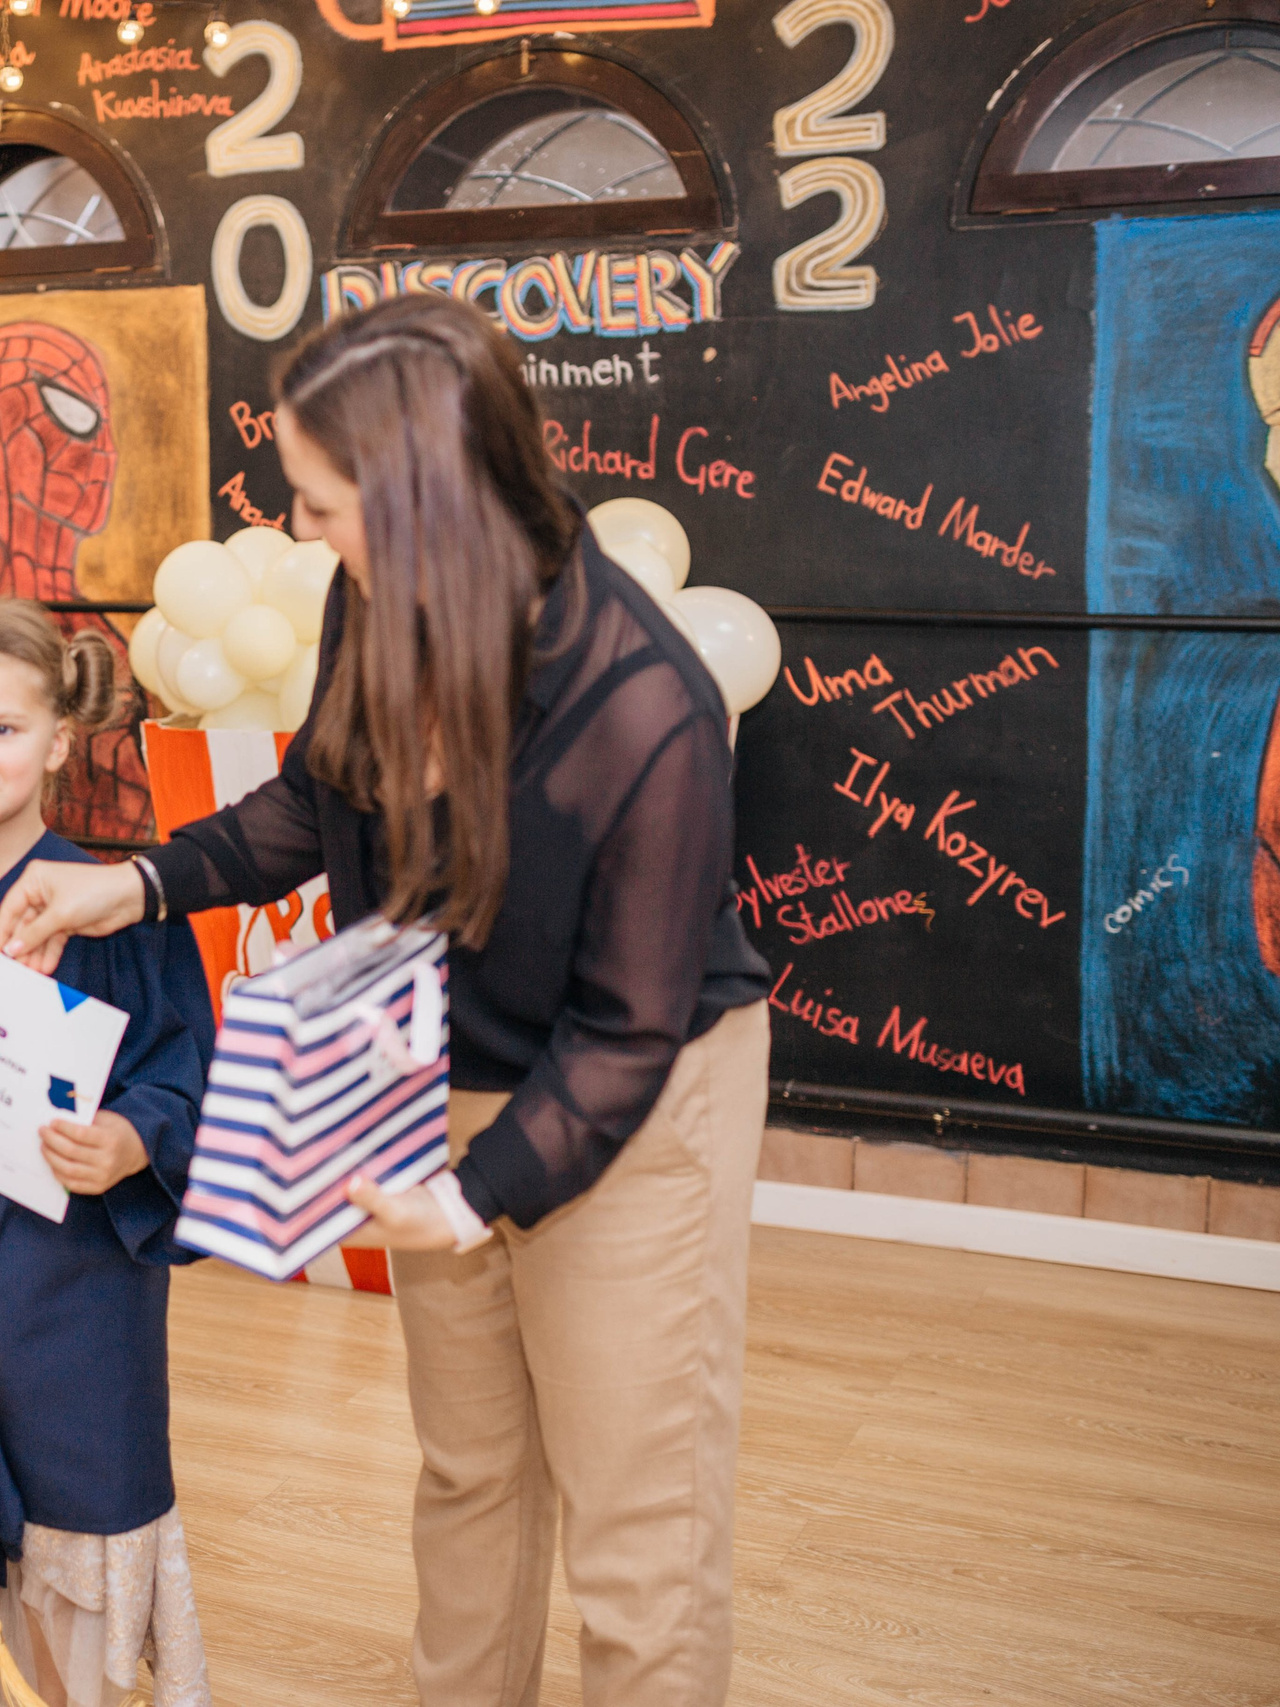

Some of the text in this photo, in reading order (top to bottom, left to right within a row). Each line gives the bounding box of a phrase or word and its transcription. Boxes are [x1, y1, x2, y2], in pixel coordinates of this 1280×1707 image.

[77, 39, 200, 87] Anastasia
[829, 303, 1044, 414] Angelina Jolie
[541, 413, 756, 499] Richard Gere
[817, 452, 1056, 580] Edward Marder
[783, 653, 893, 706] Uma
[872, 646, 1059, 739] Thurman
[834, 746, 1066, 929] Ilya Kozyrev
[776, 888, 919, 945] Stallone
[768, 962, 1026, 1096] Luisa Musaeva
